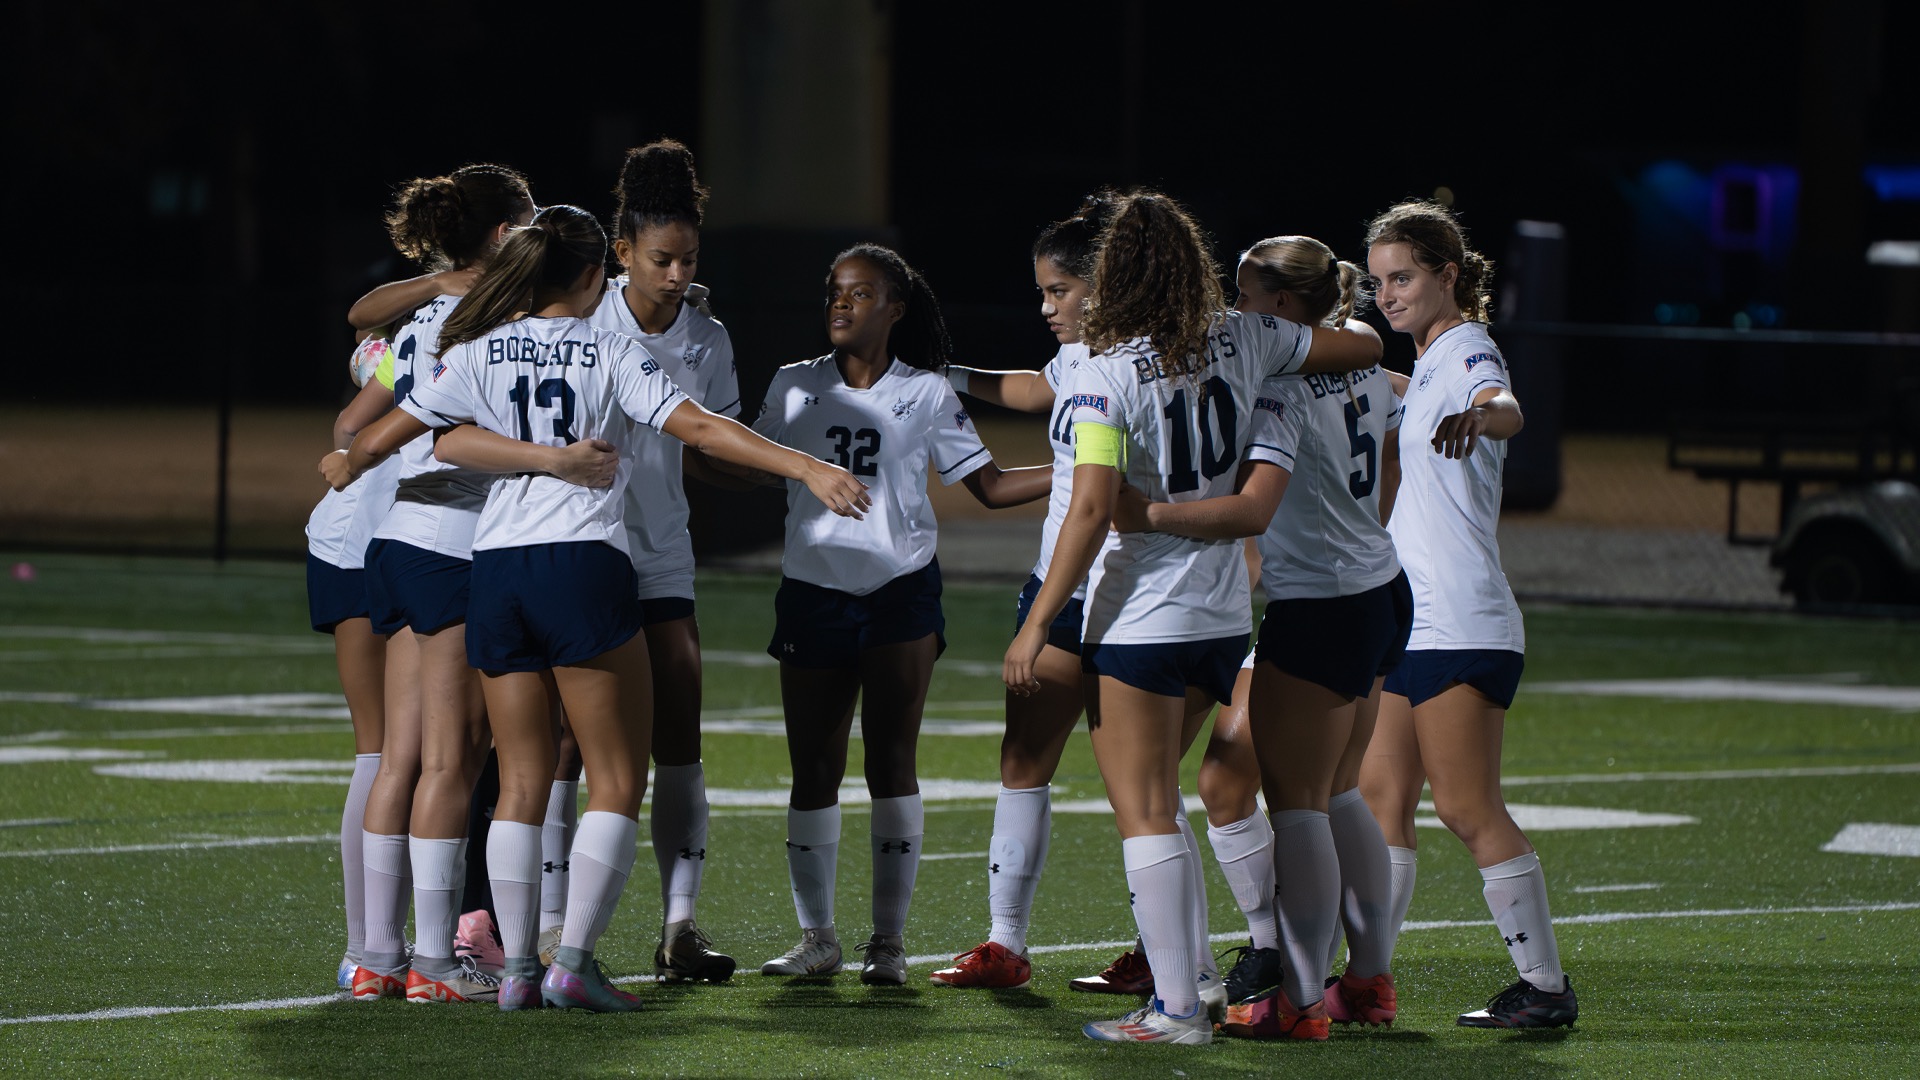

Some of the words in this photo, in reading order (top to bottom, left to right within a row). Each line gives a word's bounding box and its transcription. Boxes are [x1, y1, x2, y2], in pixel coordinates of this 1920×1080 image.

[1258, 312, 1278, 330] SU
[489, 335, 597, 369] BOBCATS
[640, 358, 661, 376] SU
[509, 375, 578, 446] 13
[1072, 394, 1107, 415] NAIA
[1254, 397, 1284, 420] AIA
[825, 425, 881, 477] 32
[1164, 375, 1237, 494] 10
[1344, 393, 1376, 500] 5
